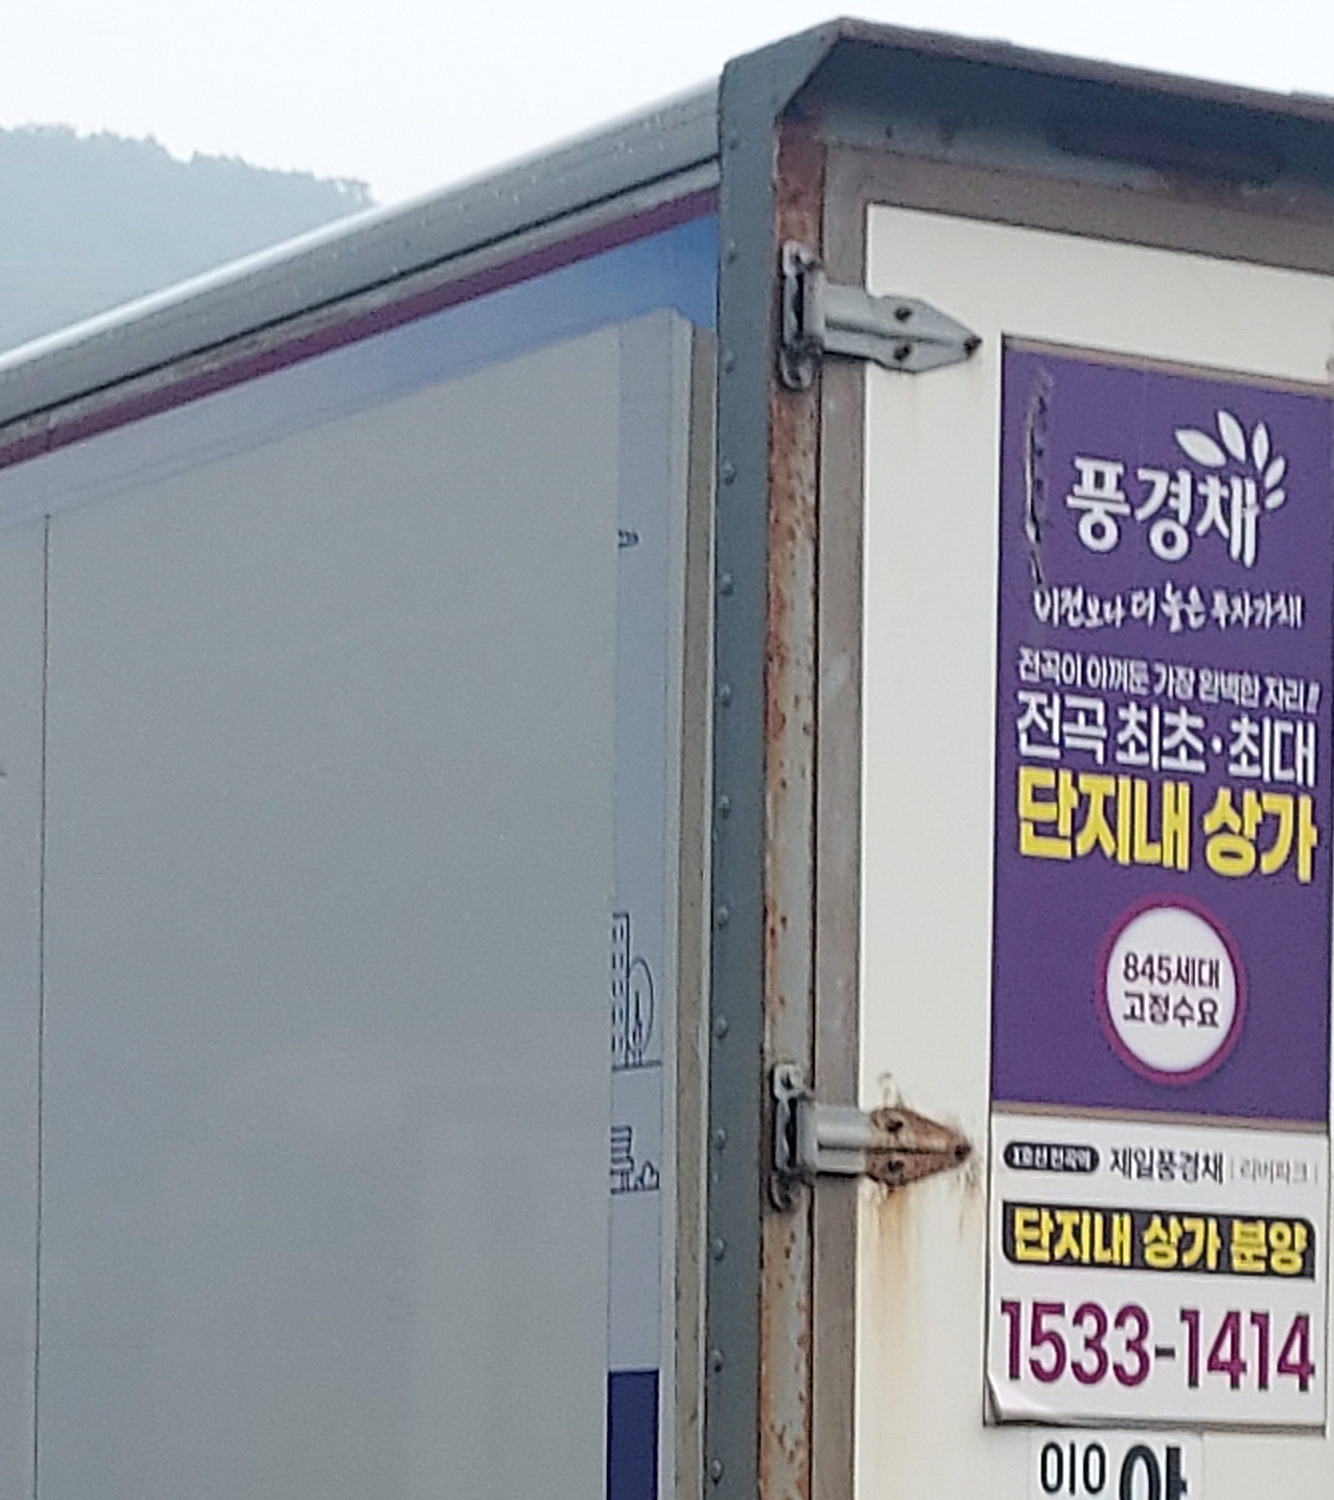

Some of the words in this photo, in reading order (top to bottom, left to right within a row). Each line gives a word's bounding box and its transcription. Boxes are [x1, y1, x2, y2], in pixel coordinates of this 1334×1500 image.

[1067, 456, 1261, 567] 풍경채
[1131, 587, 1155, 626] 더
[1160, 580, 1206, 632] 높은
[1154, 661, 1195, 700] 가장
[1016, 690, 1107, 765] 전곡
[1019, 767, 1189, 870] 단지내
[1204, 788, 1318, 883] 상가
[1123, 951, 1220, 991] 845세대
[1123, 991, 1220, 1029] 고정수요
[1014, 1207, 1132, 1266] 단지내
[1144, 1214, 1221, 1271] 상가
[1231, 1219, 1308, 1276] 분양
[1001, 1298, 1316, 1393] 1533-1414
